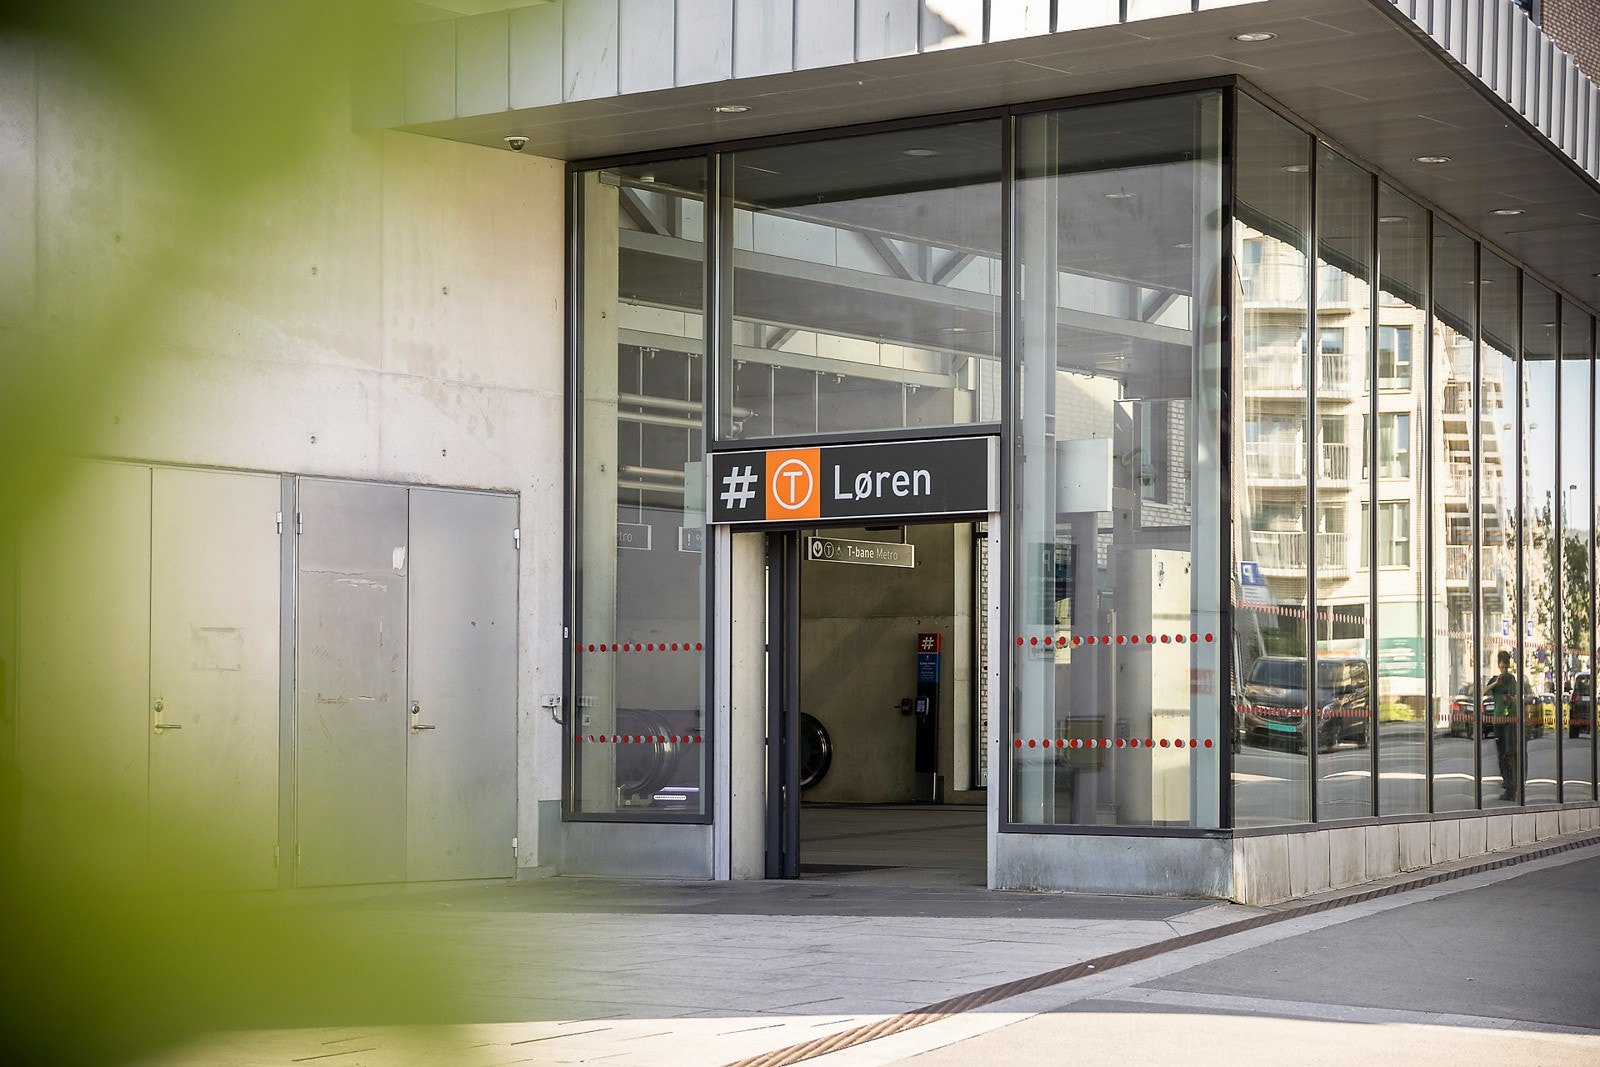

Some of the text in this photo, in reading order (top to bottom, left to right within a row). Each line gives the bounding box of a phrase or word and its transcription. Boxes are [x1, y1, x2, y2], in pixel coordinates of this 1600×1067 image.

[834, 464, 931, 501] Løren
[847, 545, 874, 559] T-bane
[876, 547, 898, 561] Metro
